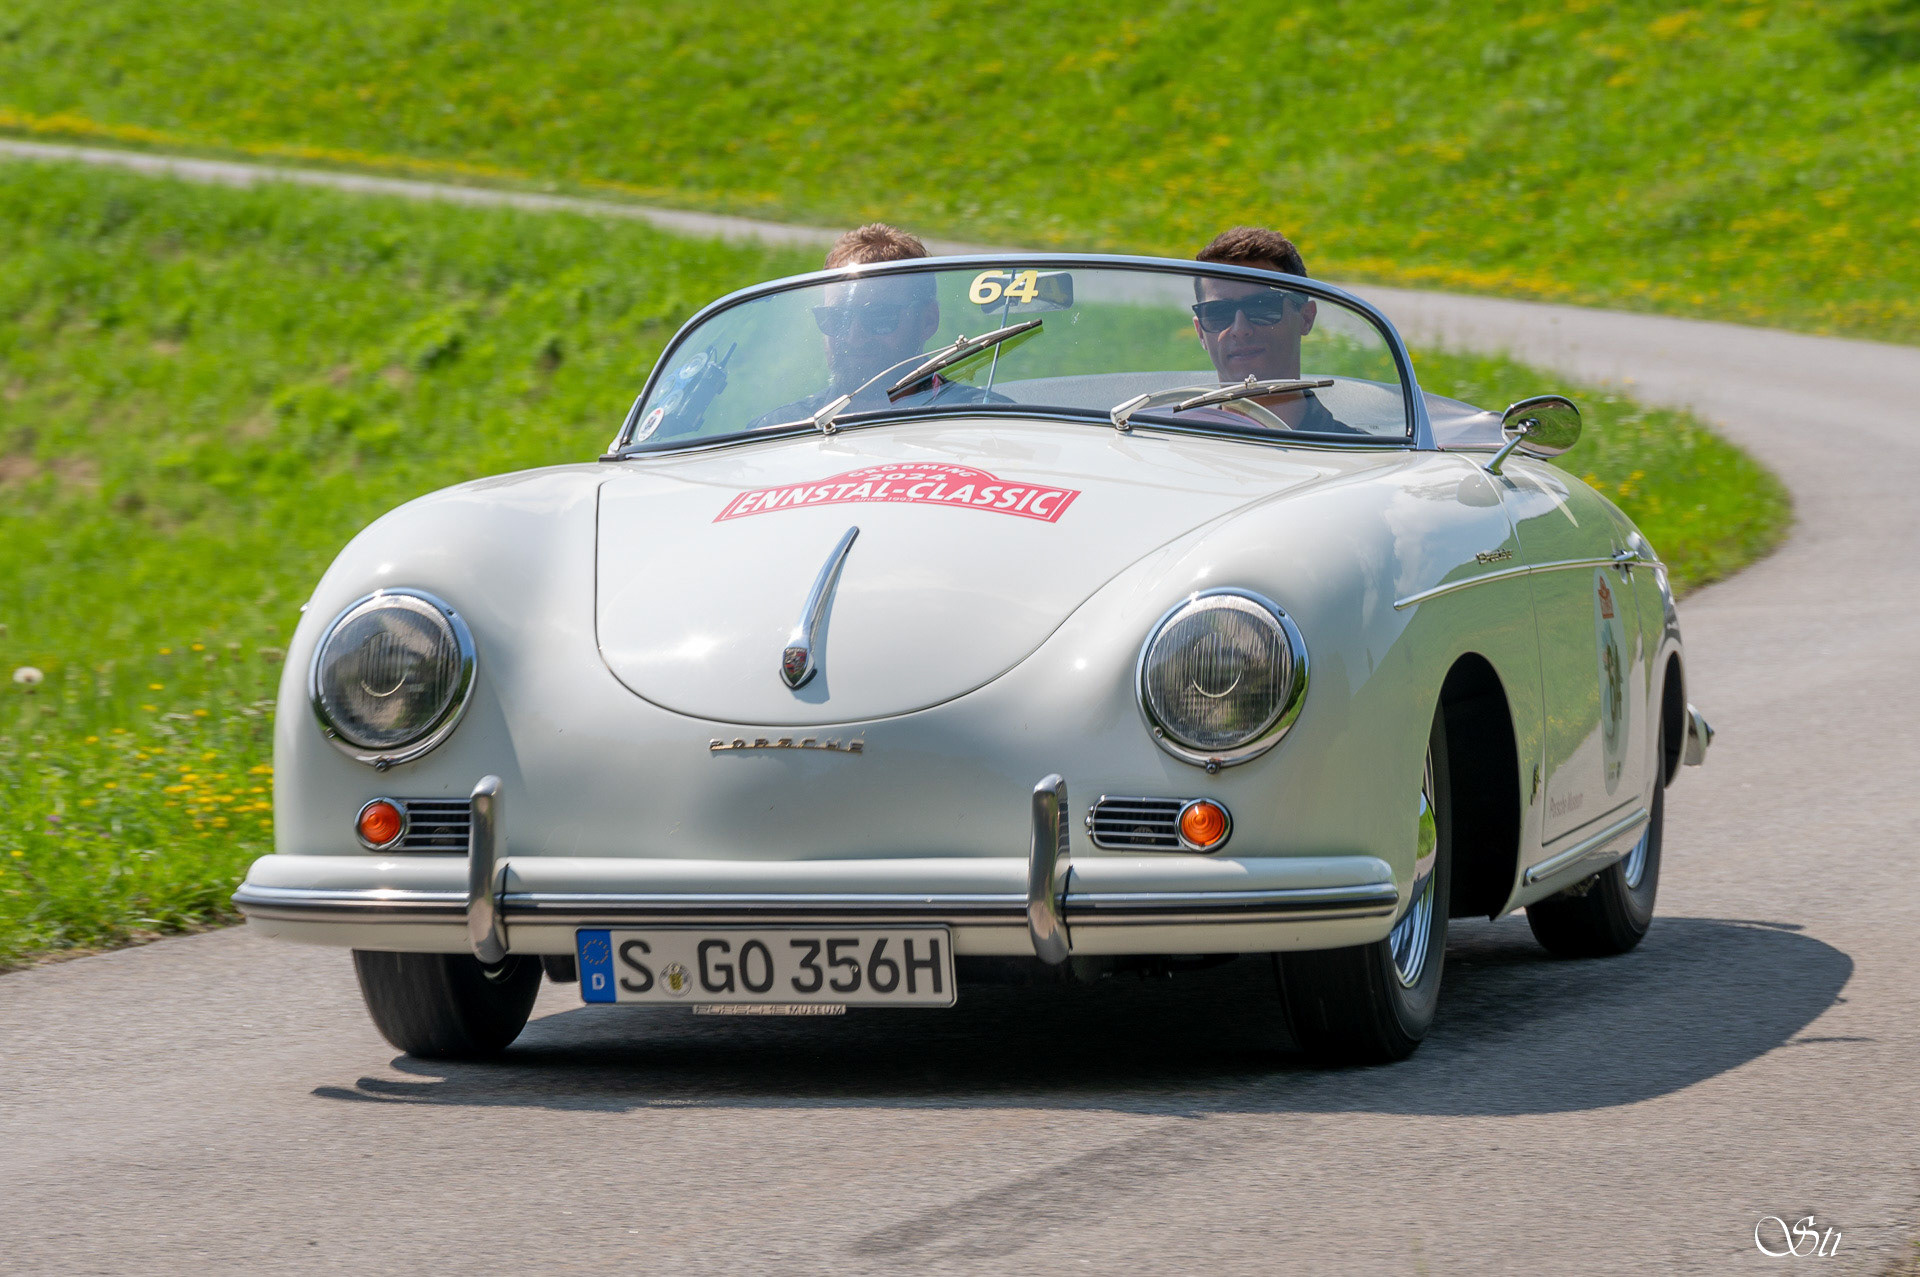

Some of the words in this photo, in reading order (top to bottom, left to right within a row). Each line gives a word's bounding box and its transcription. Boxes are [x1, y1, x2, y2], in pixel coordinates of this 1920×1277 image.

[969, 270, 1039, 304] 64
[863, 472, 947, 481] 2024
[732, 481, 1060, 515] ENNSTAL-CLASSIC
[709, 737, 865, 753] PORSCHE
[619, 939, 654, 993] S
[697, 939, 774, 994] GO
[789, 939, 943, 994] 356H
[591, 972, 605, 991] D
[788, 1005, 847, 1015] MUSEUM
